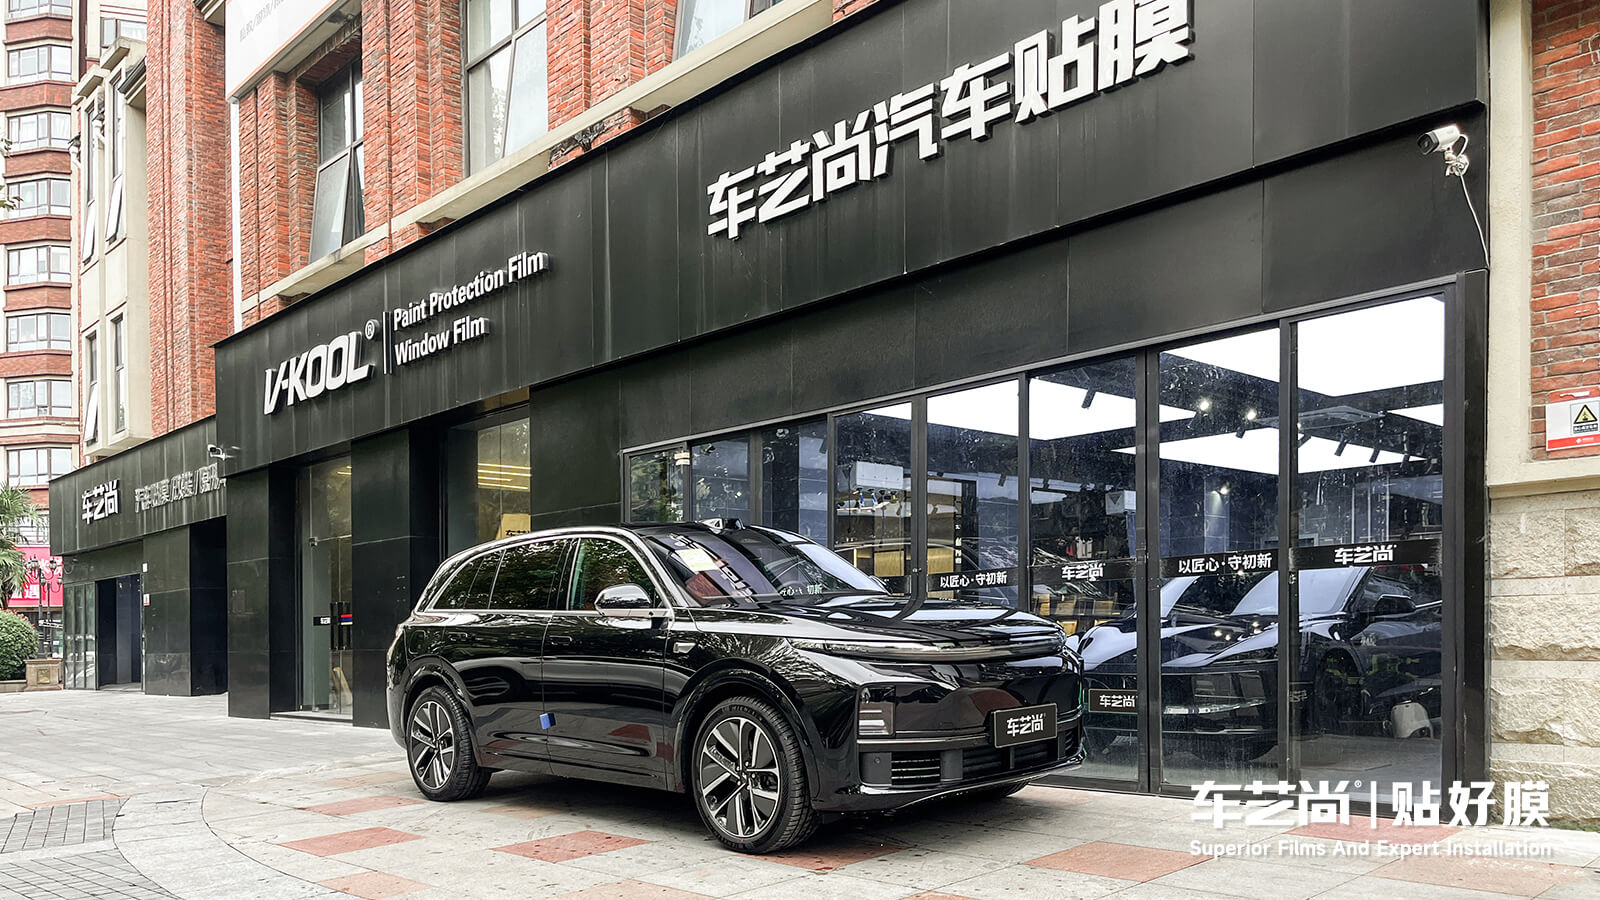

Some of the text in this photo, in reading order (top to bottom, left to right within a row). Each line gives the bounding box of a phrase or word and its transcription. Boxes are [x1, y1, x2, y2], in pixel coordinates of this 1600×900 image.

[707, 0, 1190, 239] 车艺尚汽车贴膜
[393, 251, 545, 331] Paint Protection Film
[394, 315, 486, 366] Window Film
[81, 480, 119, 524] 车艺尚
[1178, 552, 1273, 574] 以匠心·守初新
[1334, 545, 1398, 565] 车艺尚
[1061, 562, 1106, 580] 车艺尚
[1099, 694, 1138, 708] 车艺尚
[1006, 713, 1046, 737] 车艺尚
